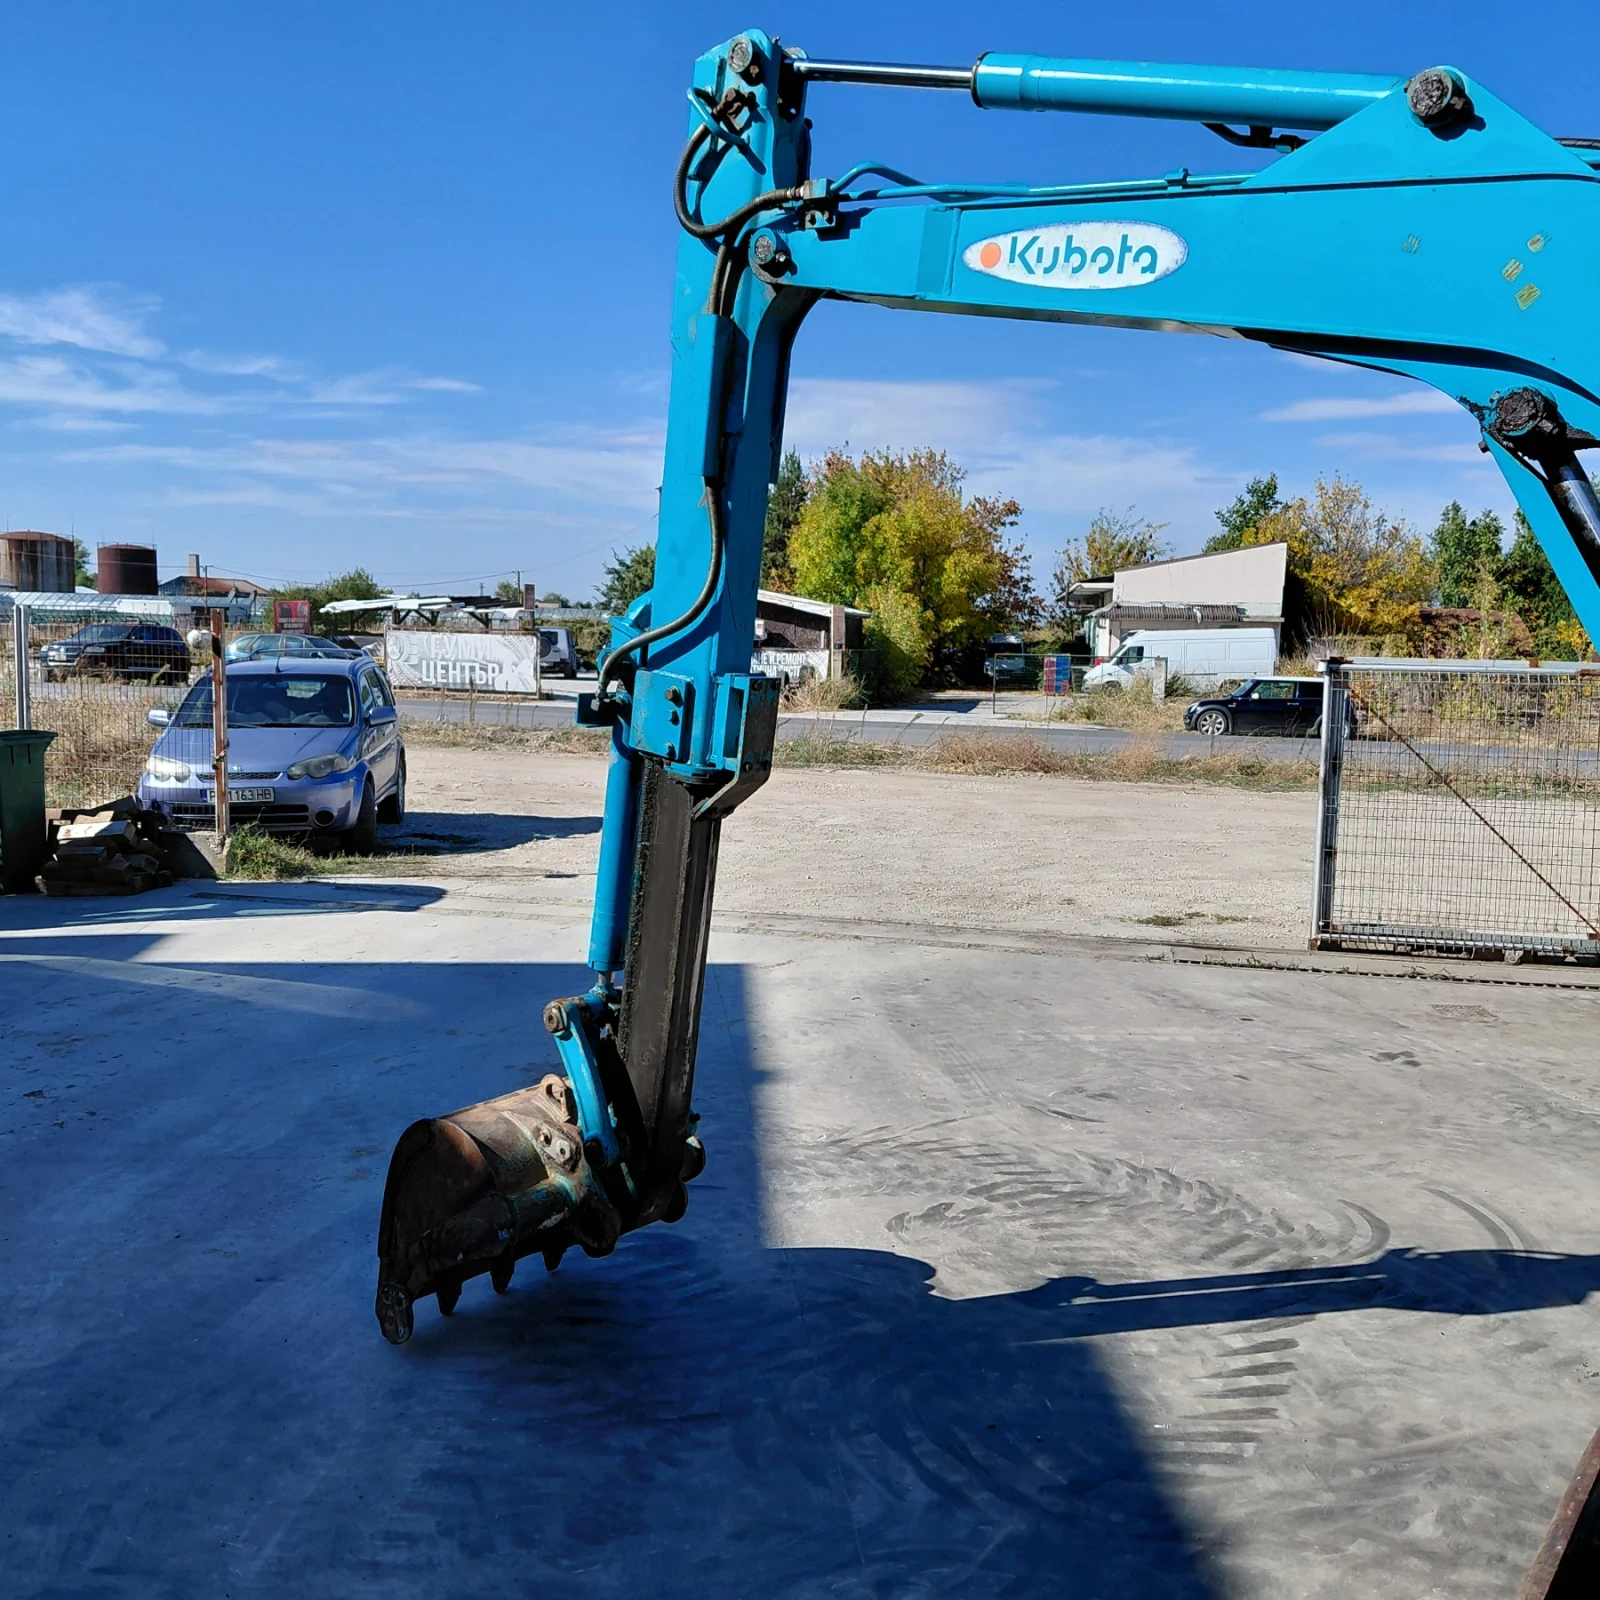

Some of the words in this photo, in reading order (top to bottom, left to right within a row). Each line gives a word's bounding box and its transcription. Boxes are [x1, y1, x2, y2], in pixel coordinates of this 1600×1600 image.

[1008, 233, 1159, 275] Kubota
[430, 634, 493, 661] ГУМИ
[421, 660, 500, 685] ЦЕНТЪР
[228, 789, 254, 801] 1163
[256, 788, 272, 800] HB
